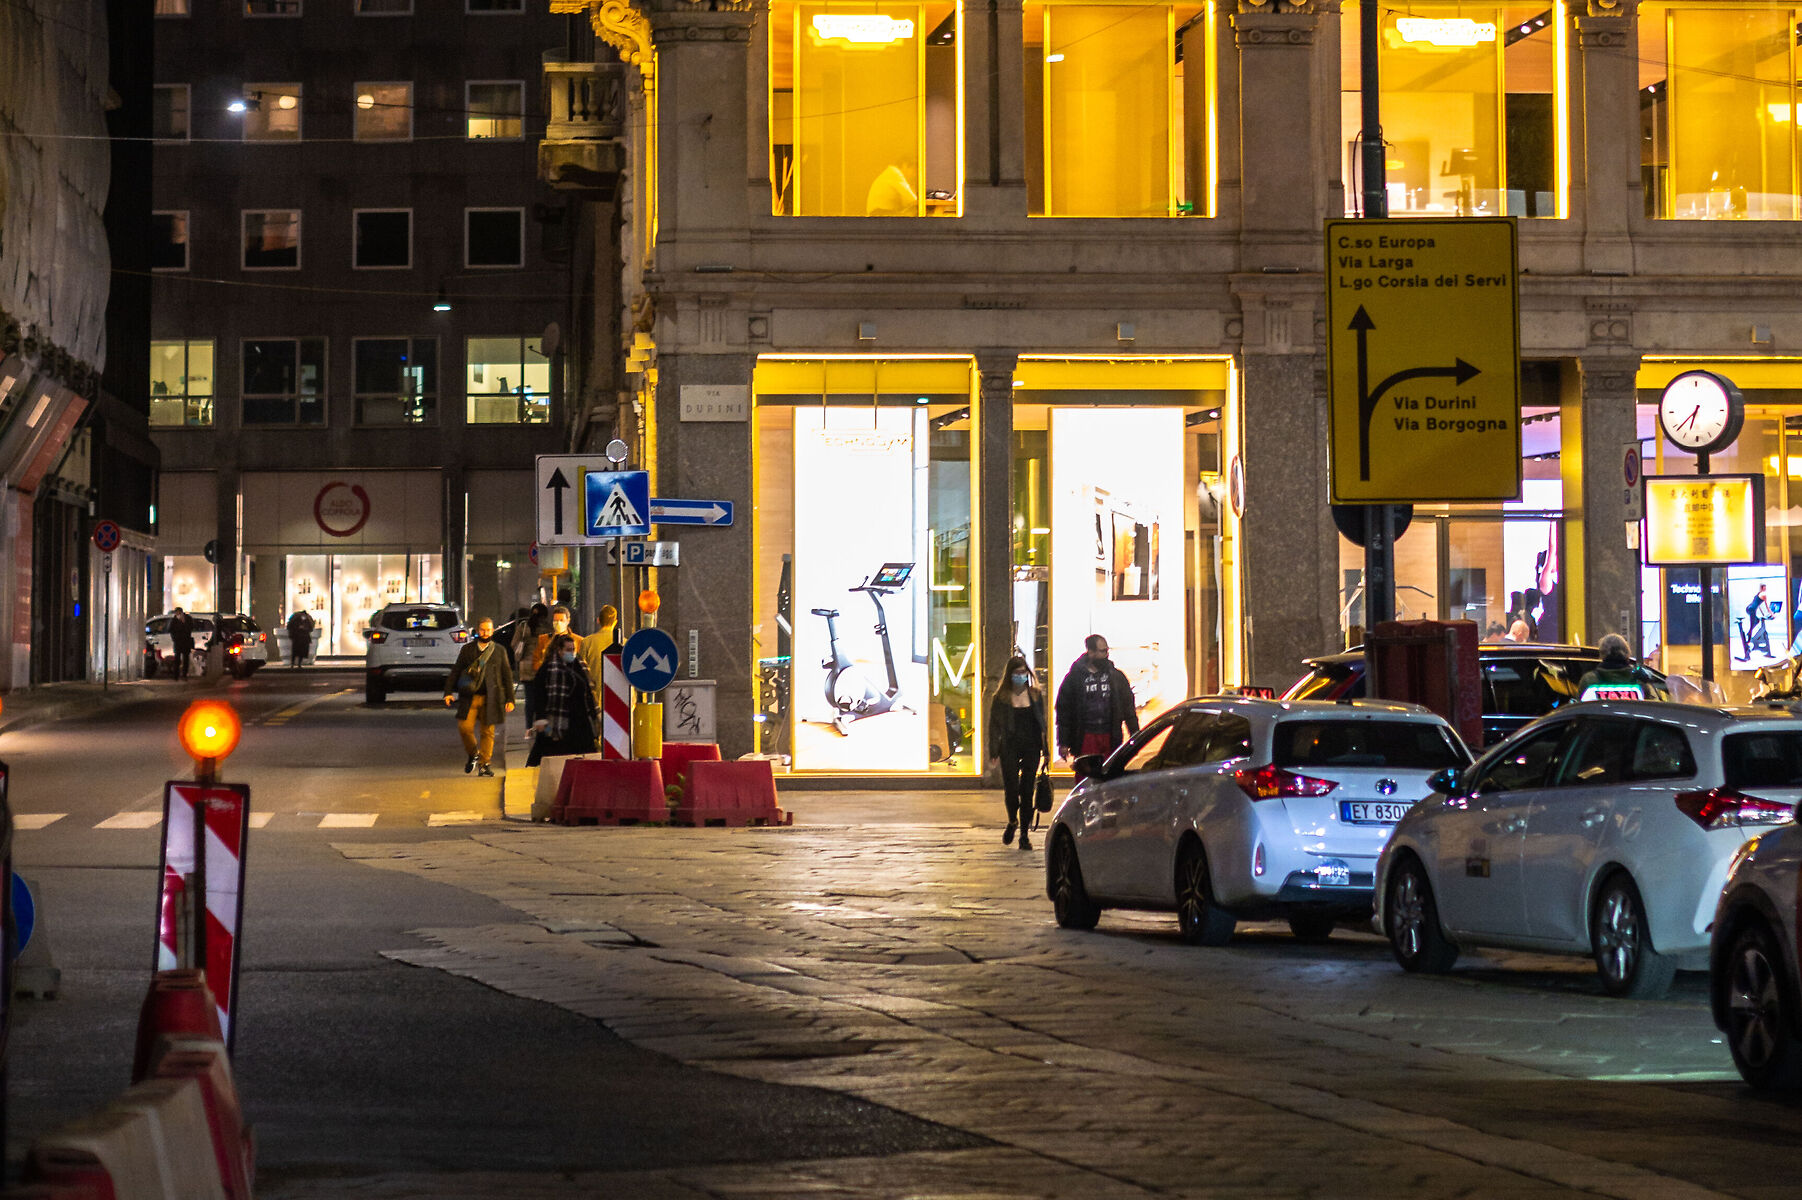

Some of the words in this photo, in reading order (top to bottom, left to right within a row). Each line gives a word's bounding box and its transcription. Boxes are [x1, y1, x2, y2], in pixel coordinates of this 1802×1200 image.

[1338, 235, 1373, 249] C.so
[1379, 235, 1436, 250] Europa
[1339, 255, 1363, 268] Via
[1369, 255, 1414, 270] Larga
[1339, 275, 1373, 290] L.go
[1378, 275, 1429, 288] Corsia
[1435, 274, 1459, 287] dei
[1465, 273, 1507, 287] Servi
[1394, 395, 1419, 410] Via
[1425, 395, 1477, 410] Durini
[1394, 417, 1420, 431] Via
[1426, 417, 1508, 433] Borgogna
[631, 545, 641, 561] P
[1243, 688, 1273, 700] TAXI
[1597, 691, 1638, 701] TAXI
[1352, 804, 1369, 819] EY
